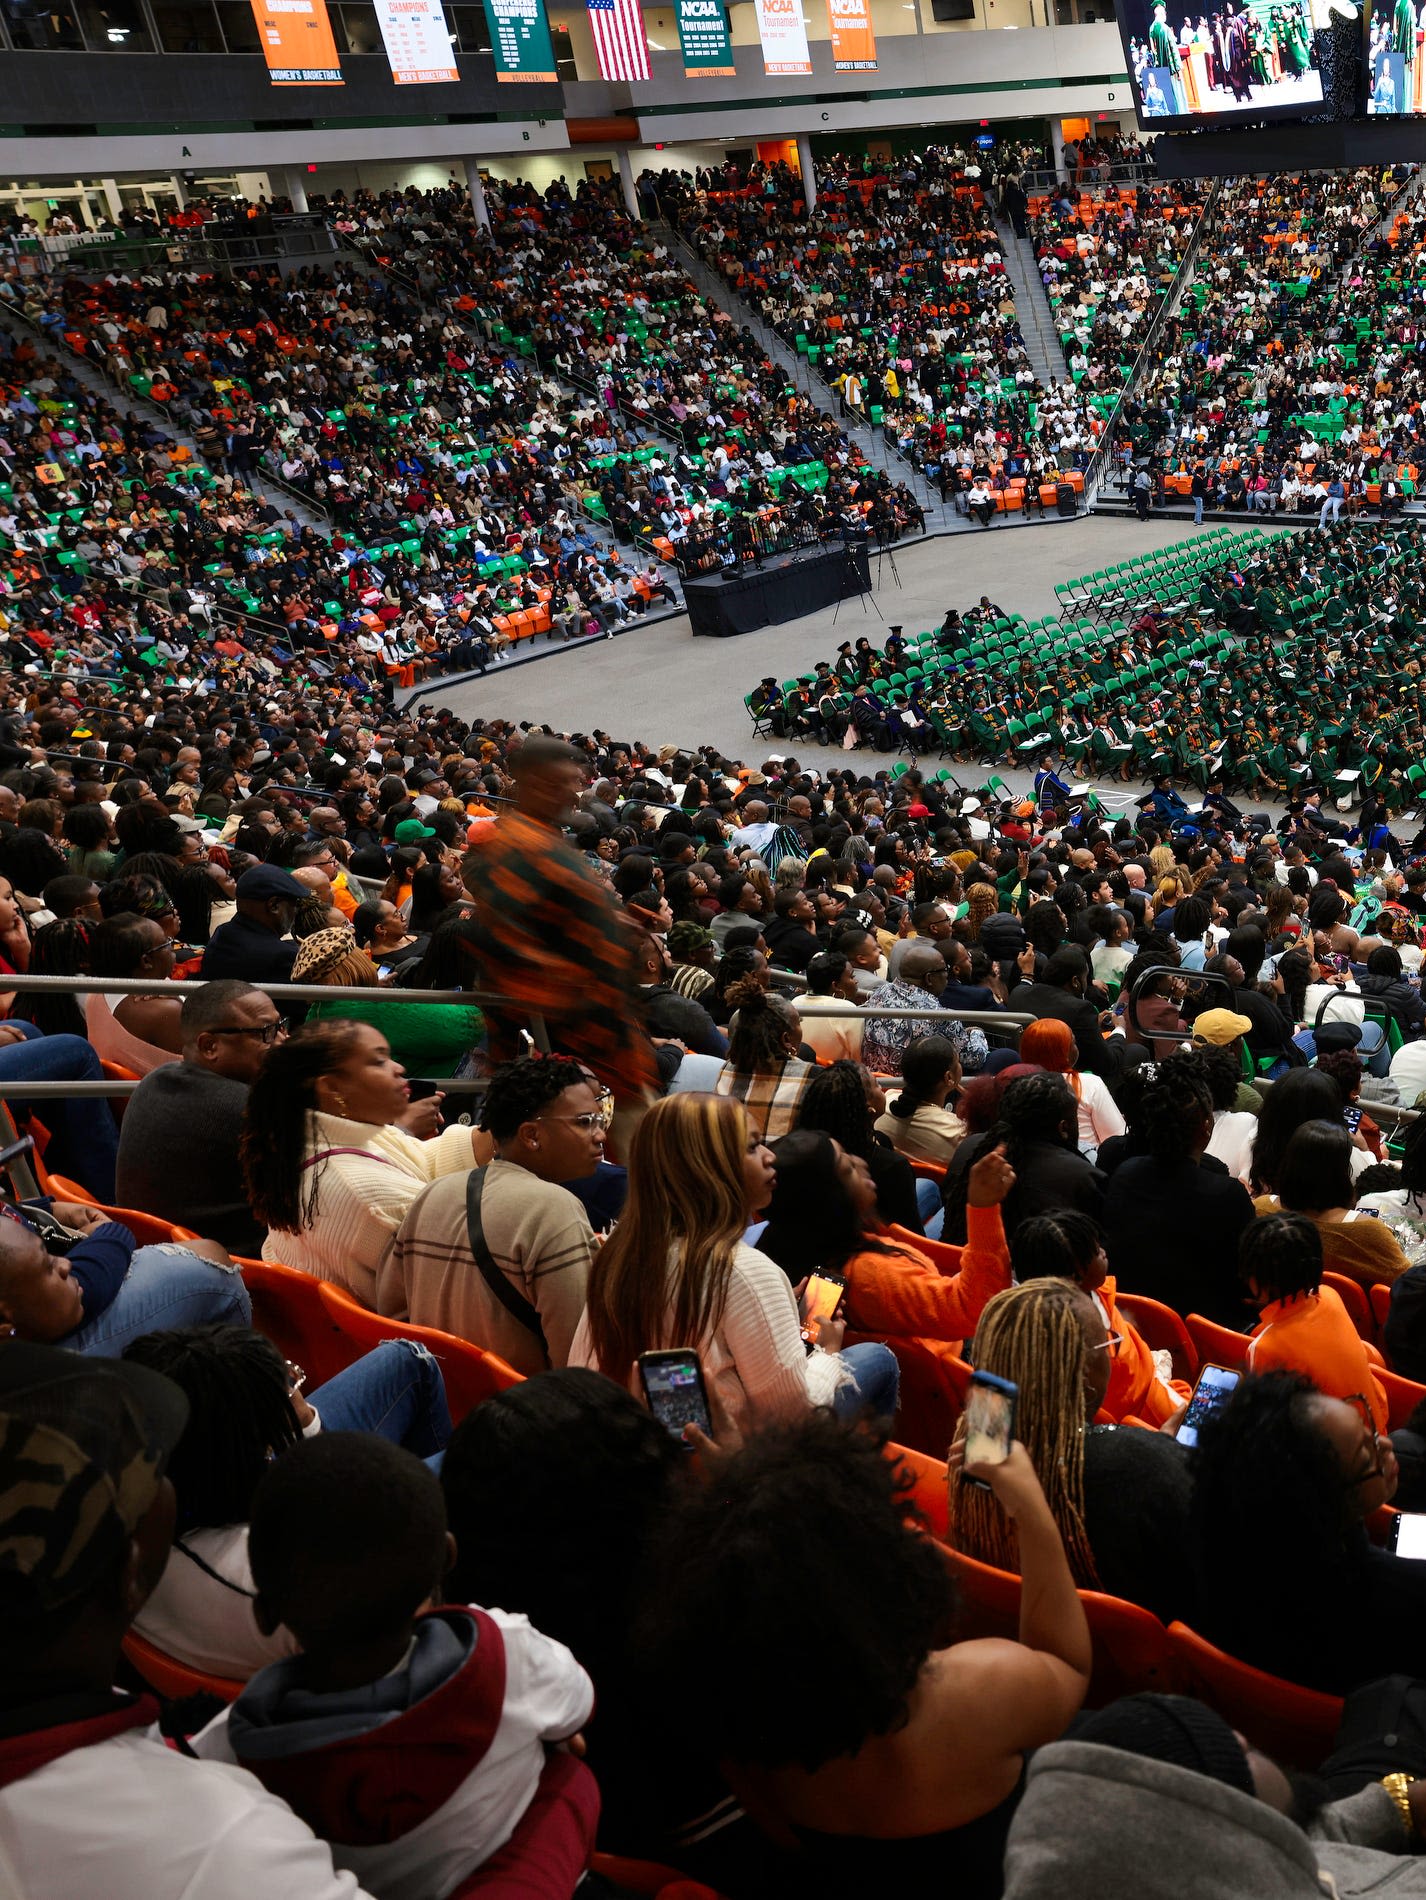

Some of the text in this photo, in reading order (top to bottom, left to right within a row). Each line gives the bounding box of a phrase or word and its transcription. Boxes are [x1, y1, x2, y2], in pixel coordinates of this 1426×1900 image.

[493, 5, 538, 17] CHAMPIONS
[681, 1, 718, 16] NCAA
[763, 0, 794, 13] NCAA
[831, 0, 865, 15] NCAA
[680, 19, 724, 31] Tournament
[269, 70, 342, 80] WOMEN'S BASKETBALL
[1106, 91, 1115, 100] D
[821, 112, 829, 121] C
[522, 131, 530, 141] B
[182, 146, 191, 157] A
